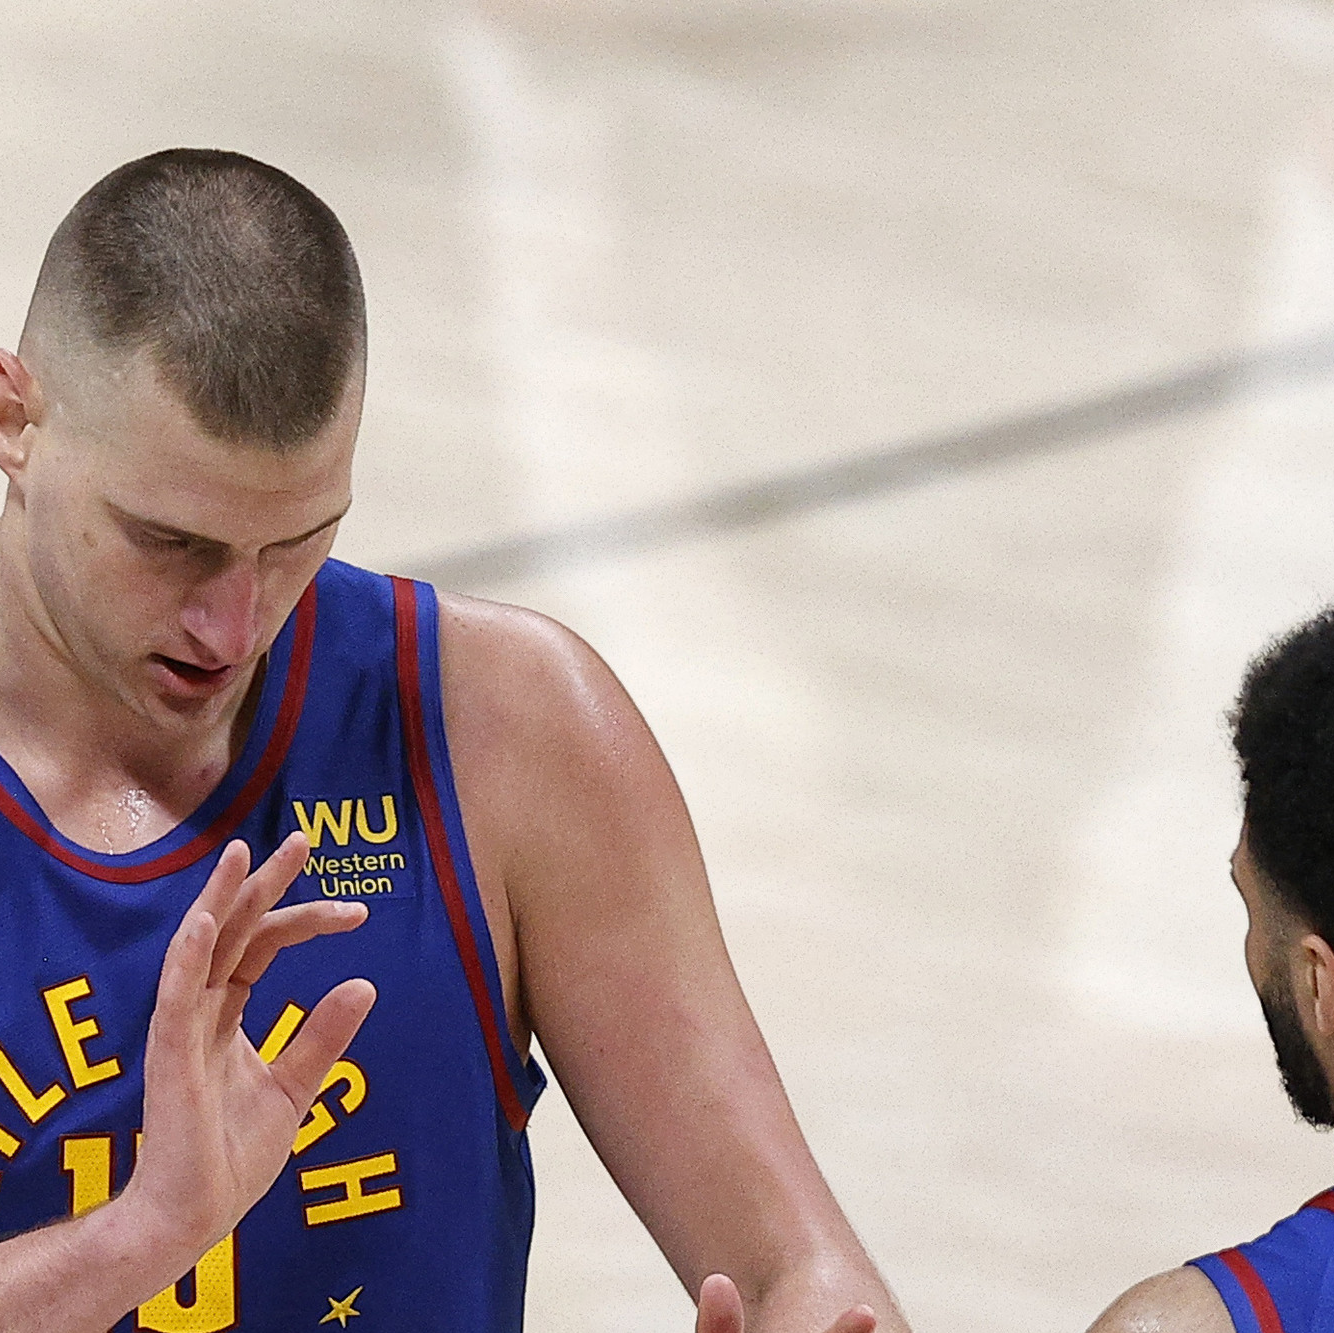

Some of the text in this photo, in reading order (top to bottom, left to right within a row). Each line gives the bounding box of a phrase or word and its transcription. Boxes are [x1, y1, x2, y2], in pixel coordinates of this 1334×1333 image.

[292, 794, 398, 848] WU
[303, 853, 405, 876] Western
[320, 873, 393, 898] Union
[256, 999, 405, 1228] IGH
